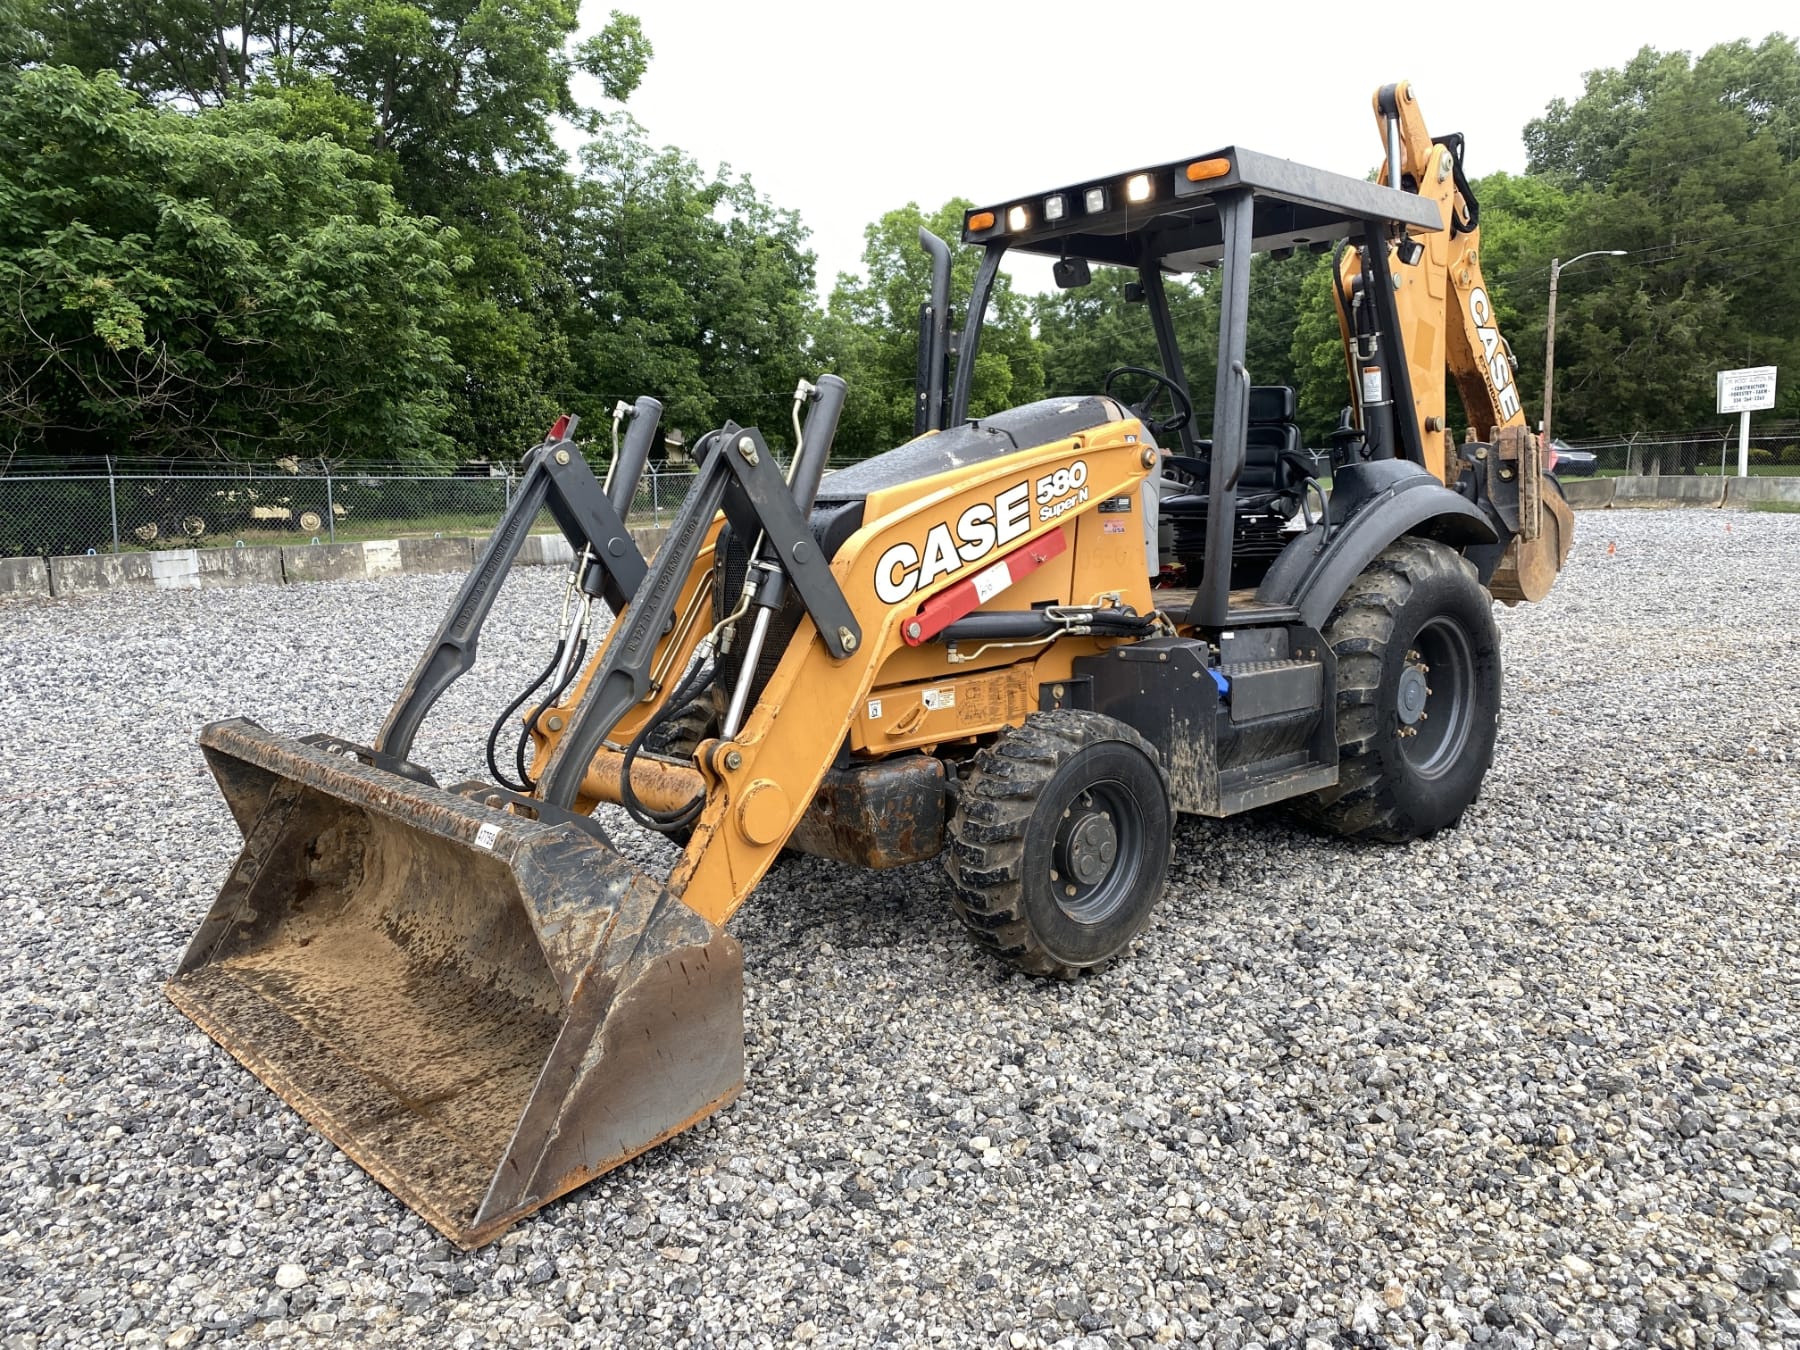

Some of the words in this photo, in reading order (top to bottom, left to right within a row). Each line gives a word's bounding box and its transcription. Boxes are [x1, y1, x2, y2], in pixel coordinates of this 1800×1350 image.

[1469, 287, 1521, 423] CASE
[1036, 459, 1088, 505] 580
[1039, 495, 1077, 522] Super
[1078, 485, 1089, 504] N
[874, 480, 1032, 604] CASE
